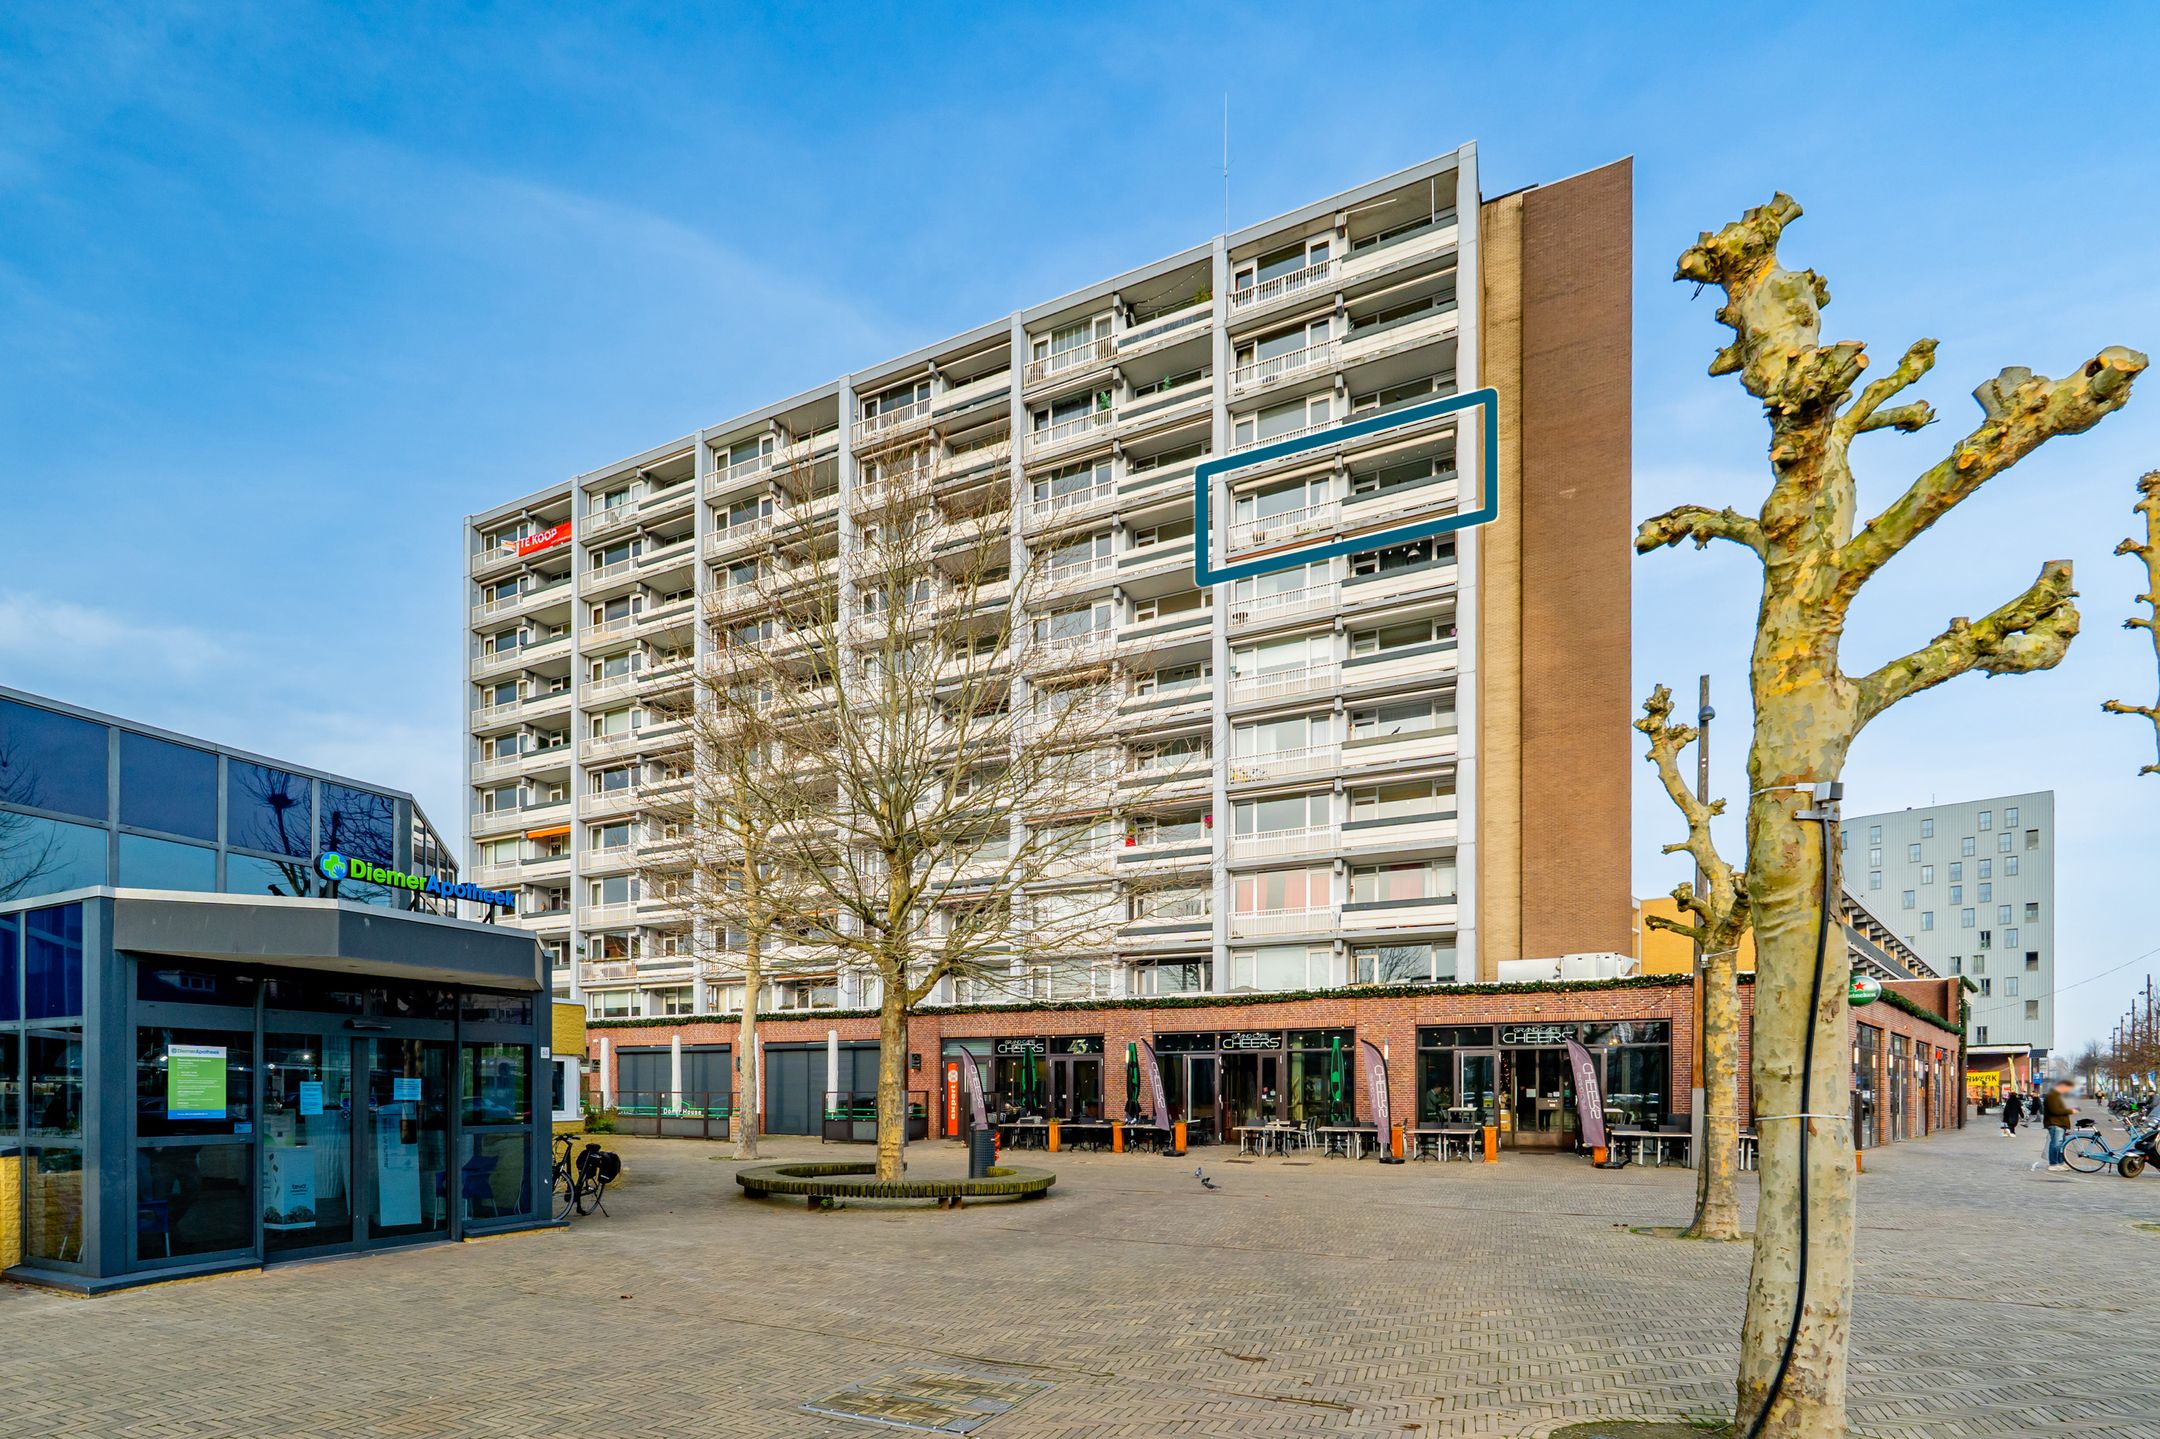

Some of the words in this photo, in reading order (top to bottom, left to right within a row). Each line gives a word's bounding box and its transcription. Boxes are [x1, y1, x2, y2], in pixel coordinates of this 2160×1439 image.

[519, 536, 530, 548] TE
[531, 528, 557, 545] KOOP
[350, 858, 516, 908] DiemerApotheek
[997, 1043, 1044, 1053] CHEERS
[1067, 1039, 1087, 1054] 43
[1222, 1037, 1281, 1048] CHEERS
[1502, 1031, 1575, 1044] CHEERS
[970, 1064, 985, 1108] CHEERS
[1151, 1061, 1166, 1109] CHEERS
[1374, 1064, 1388, 1118] CHEERS
[1582, 1062, 1601, 1119] CHEERS
